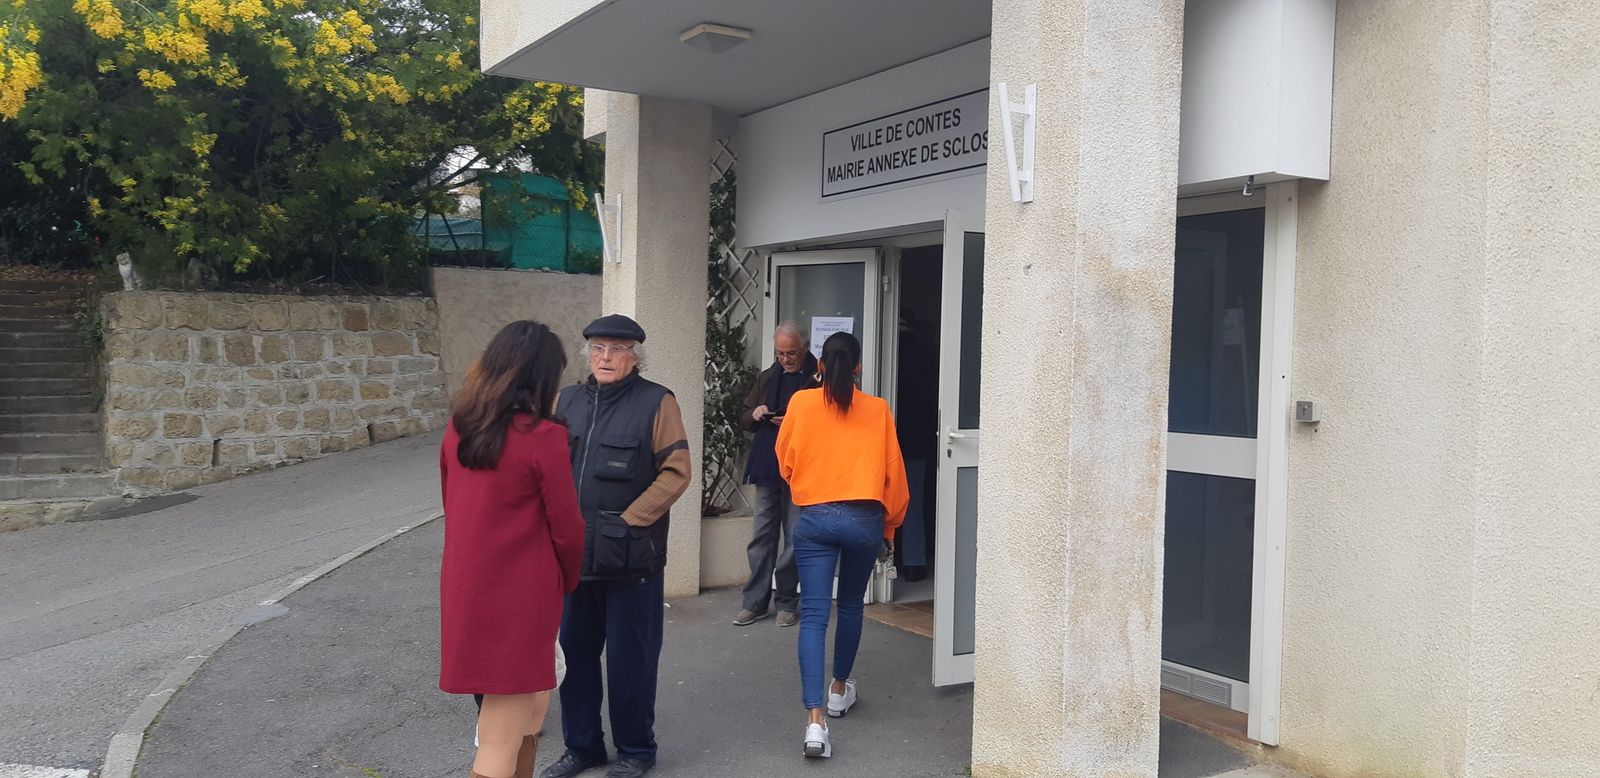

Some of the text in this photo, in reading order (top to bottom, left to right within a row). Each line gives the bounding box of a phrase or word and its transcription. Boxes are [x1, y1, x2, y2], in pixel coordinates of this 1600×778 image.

[850, 108, 961, 152] VILLE DE CONTES
[827, 159, 865, 183] MAIRIE
[867, 147, 917, 175] ANNEXE
[921, 142, 939, 163] DE
